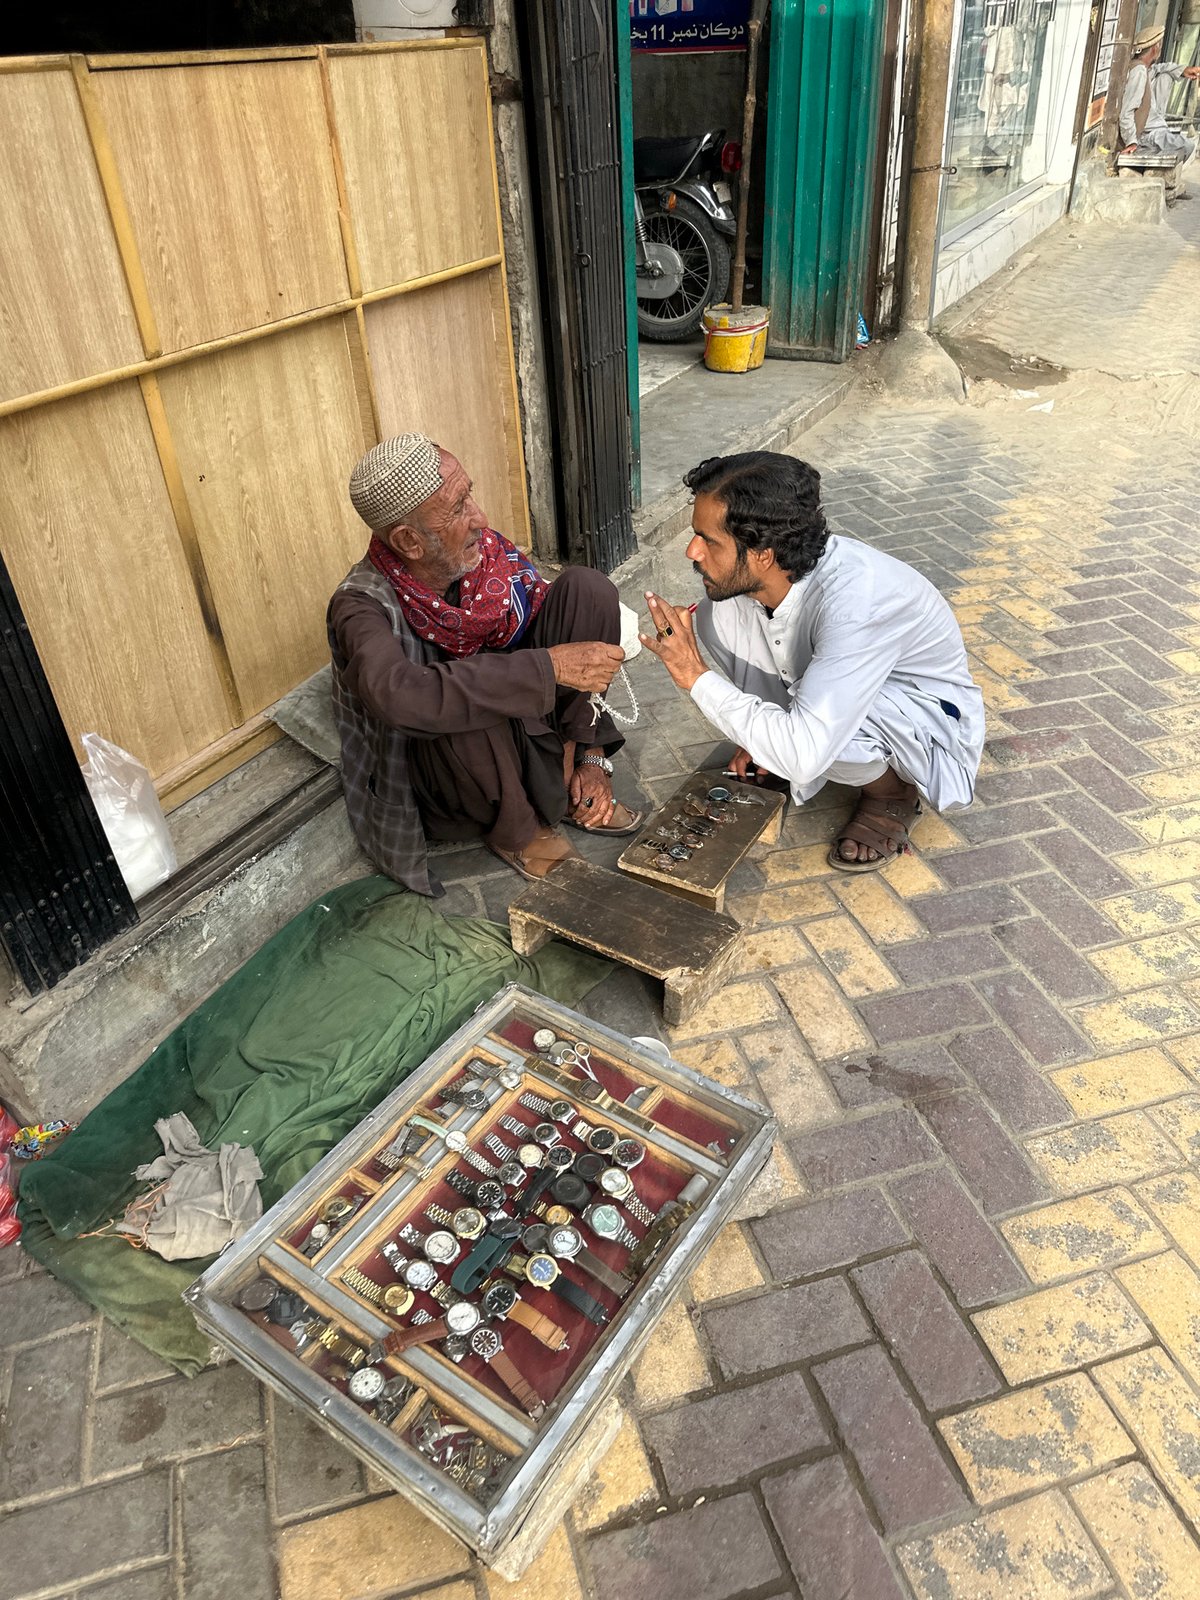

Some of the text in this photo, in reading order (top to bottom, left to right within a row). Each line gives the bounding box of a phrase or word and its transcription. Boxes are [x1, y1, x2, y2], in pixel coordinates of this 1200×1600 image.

[630, 27, 648, 44] بخ
[650, 24, 665, 40] 11
[668, 24, 698, 42] نمبر
